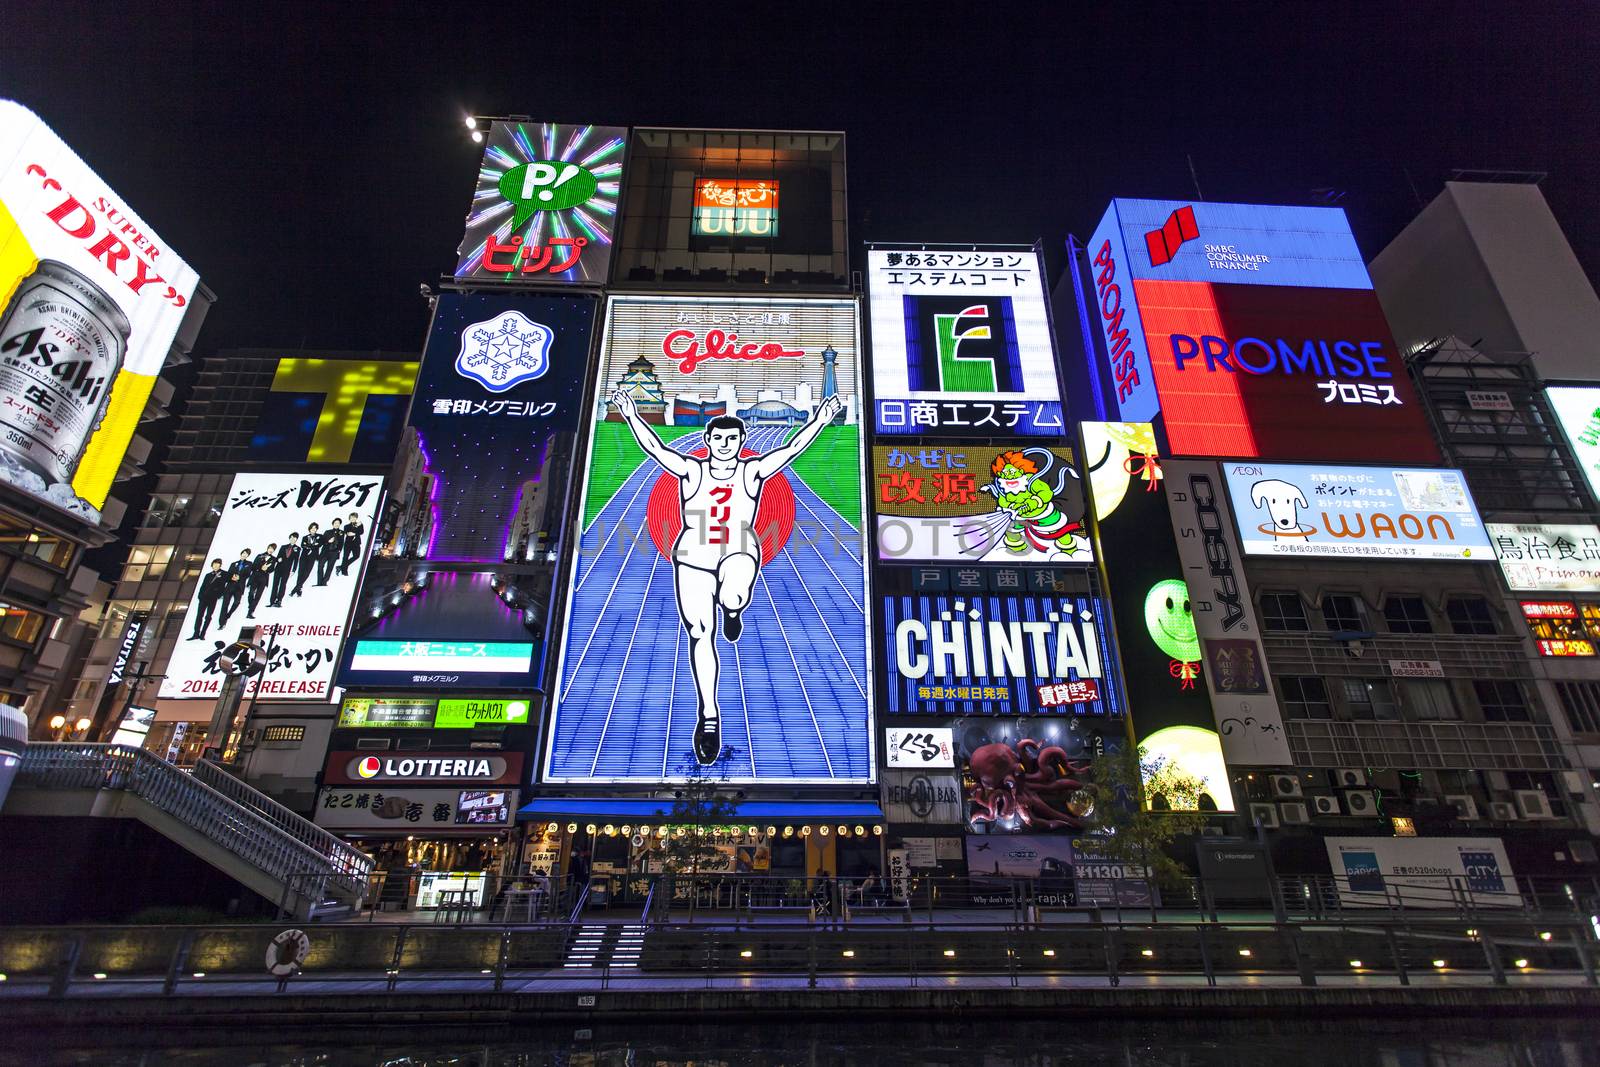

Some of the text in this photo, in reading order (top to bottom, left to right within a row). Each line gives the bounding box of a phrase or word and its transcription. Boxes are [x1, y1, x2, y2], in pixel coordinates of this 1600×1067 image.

[93, 196, 161, 262] SUPER
[482, 234, 588, 274] ピップ
[1205, 244, 1236, 254] SMBC
[1207, 253, 1270, 264] CONSUMER
[887, 252, 1022, 267] 夢あるマンション
[1209, 261, 1260, 271] FINANCE
[887, 272, 1026, 287] エステムコート
[38, 304, 58, 314] ASAHI
[677, 312, 791, 325] おいしさと健康
[1093, 239, 1141, 404] PROMISE
[663, 329, 806, 375] Glico
[1168, 334, 1392, 379] PROMISE
[1, 327, 105, 405] Asahi
[24, 384, 56, 413] 生
[1317, 381, 1403, 406] プロミス
[3, 396, 60, 433] スーパードライ
[432, 399, 557, 418] 雪印メグミルク
[880, 401, 1062, 427] 日商エステム
[6, 431, 33, 452] 350ml
[887, 449, 968, 470] かぜに
[231, 478, 378, 509] ジャニーズ WEST
[878, 471, 977, 506] 改源
[708, 484, 736, 545] グリコ
[1321, 512, 1456, 541] WAON
[919, 569, 1057, 588] 戸堂歯科
[255, 624, 341, 636] DEBUT SINGLE
[109, 622, 140, 685] TSUTAYA
[398, 642, 488, 657] 大阪ニュース
[260, 681, 327, 694] RELEASE
[412, 674, 459, 683] 雪印メグミルク
[1069, 682, 1086, 692] 住宅
[918, 687, 1009, 700] 毎週水曜日発売
[1039, 685, 1069, 706] 賃貸
[1071, 690, 1098, 701] ニュース
[466, 702, 503, 720] ピタットハウス
[899, 733, 941, 762] くくる
[385, 759, 491, 777] LOTTERIA
[937, 787, 958, 804] BAR
[324, 793, 385, 809] たこ焼き
[405, 802, 452, 823] 壱番
[1466, 865, 1499, 880] CITY
